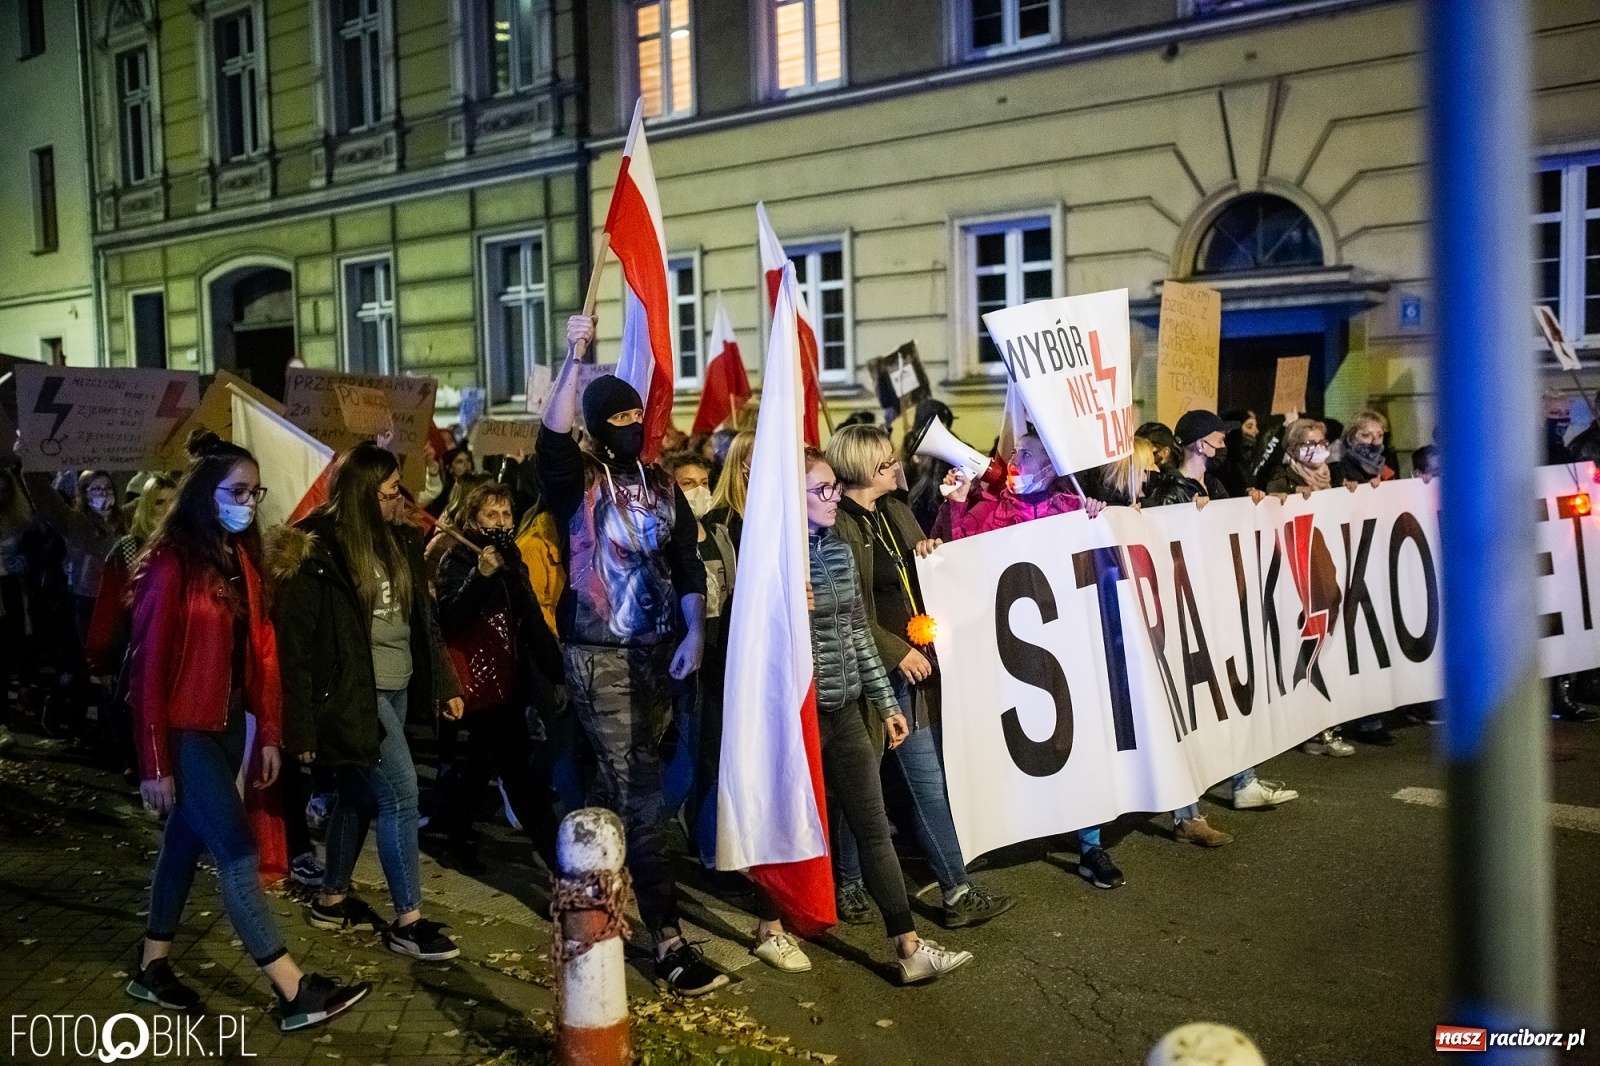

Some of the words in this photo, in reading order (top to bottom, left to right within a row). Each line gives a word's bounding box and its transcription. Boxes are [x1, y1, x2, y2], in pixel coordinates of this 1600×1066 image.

[995, 318, 1089, 383] WYBÓR
[1066, 372, 1104, 418] NIE
[995, 528, 1287, 778] STRAJK
